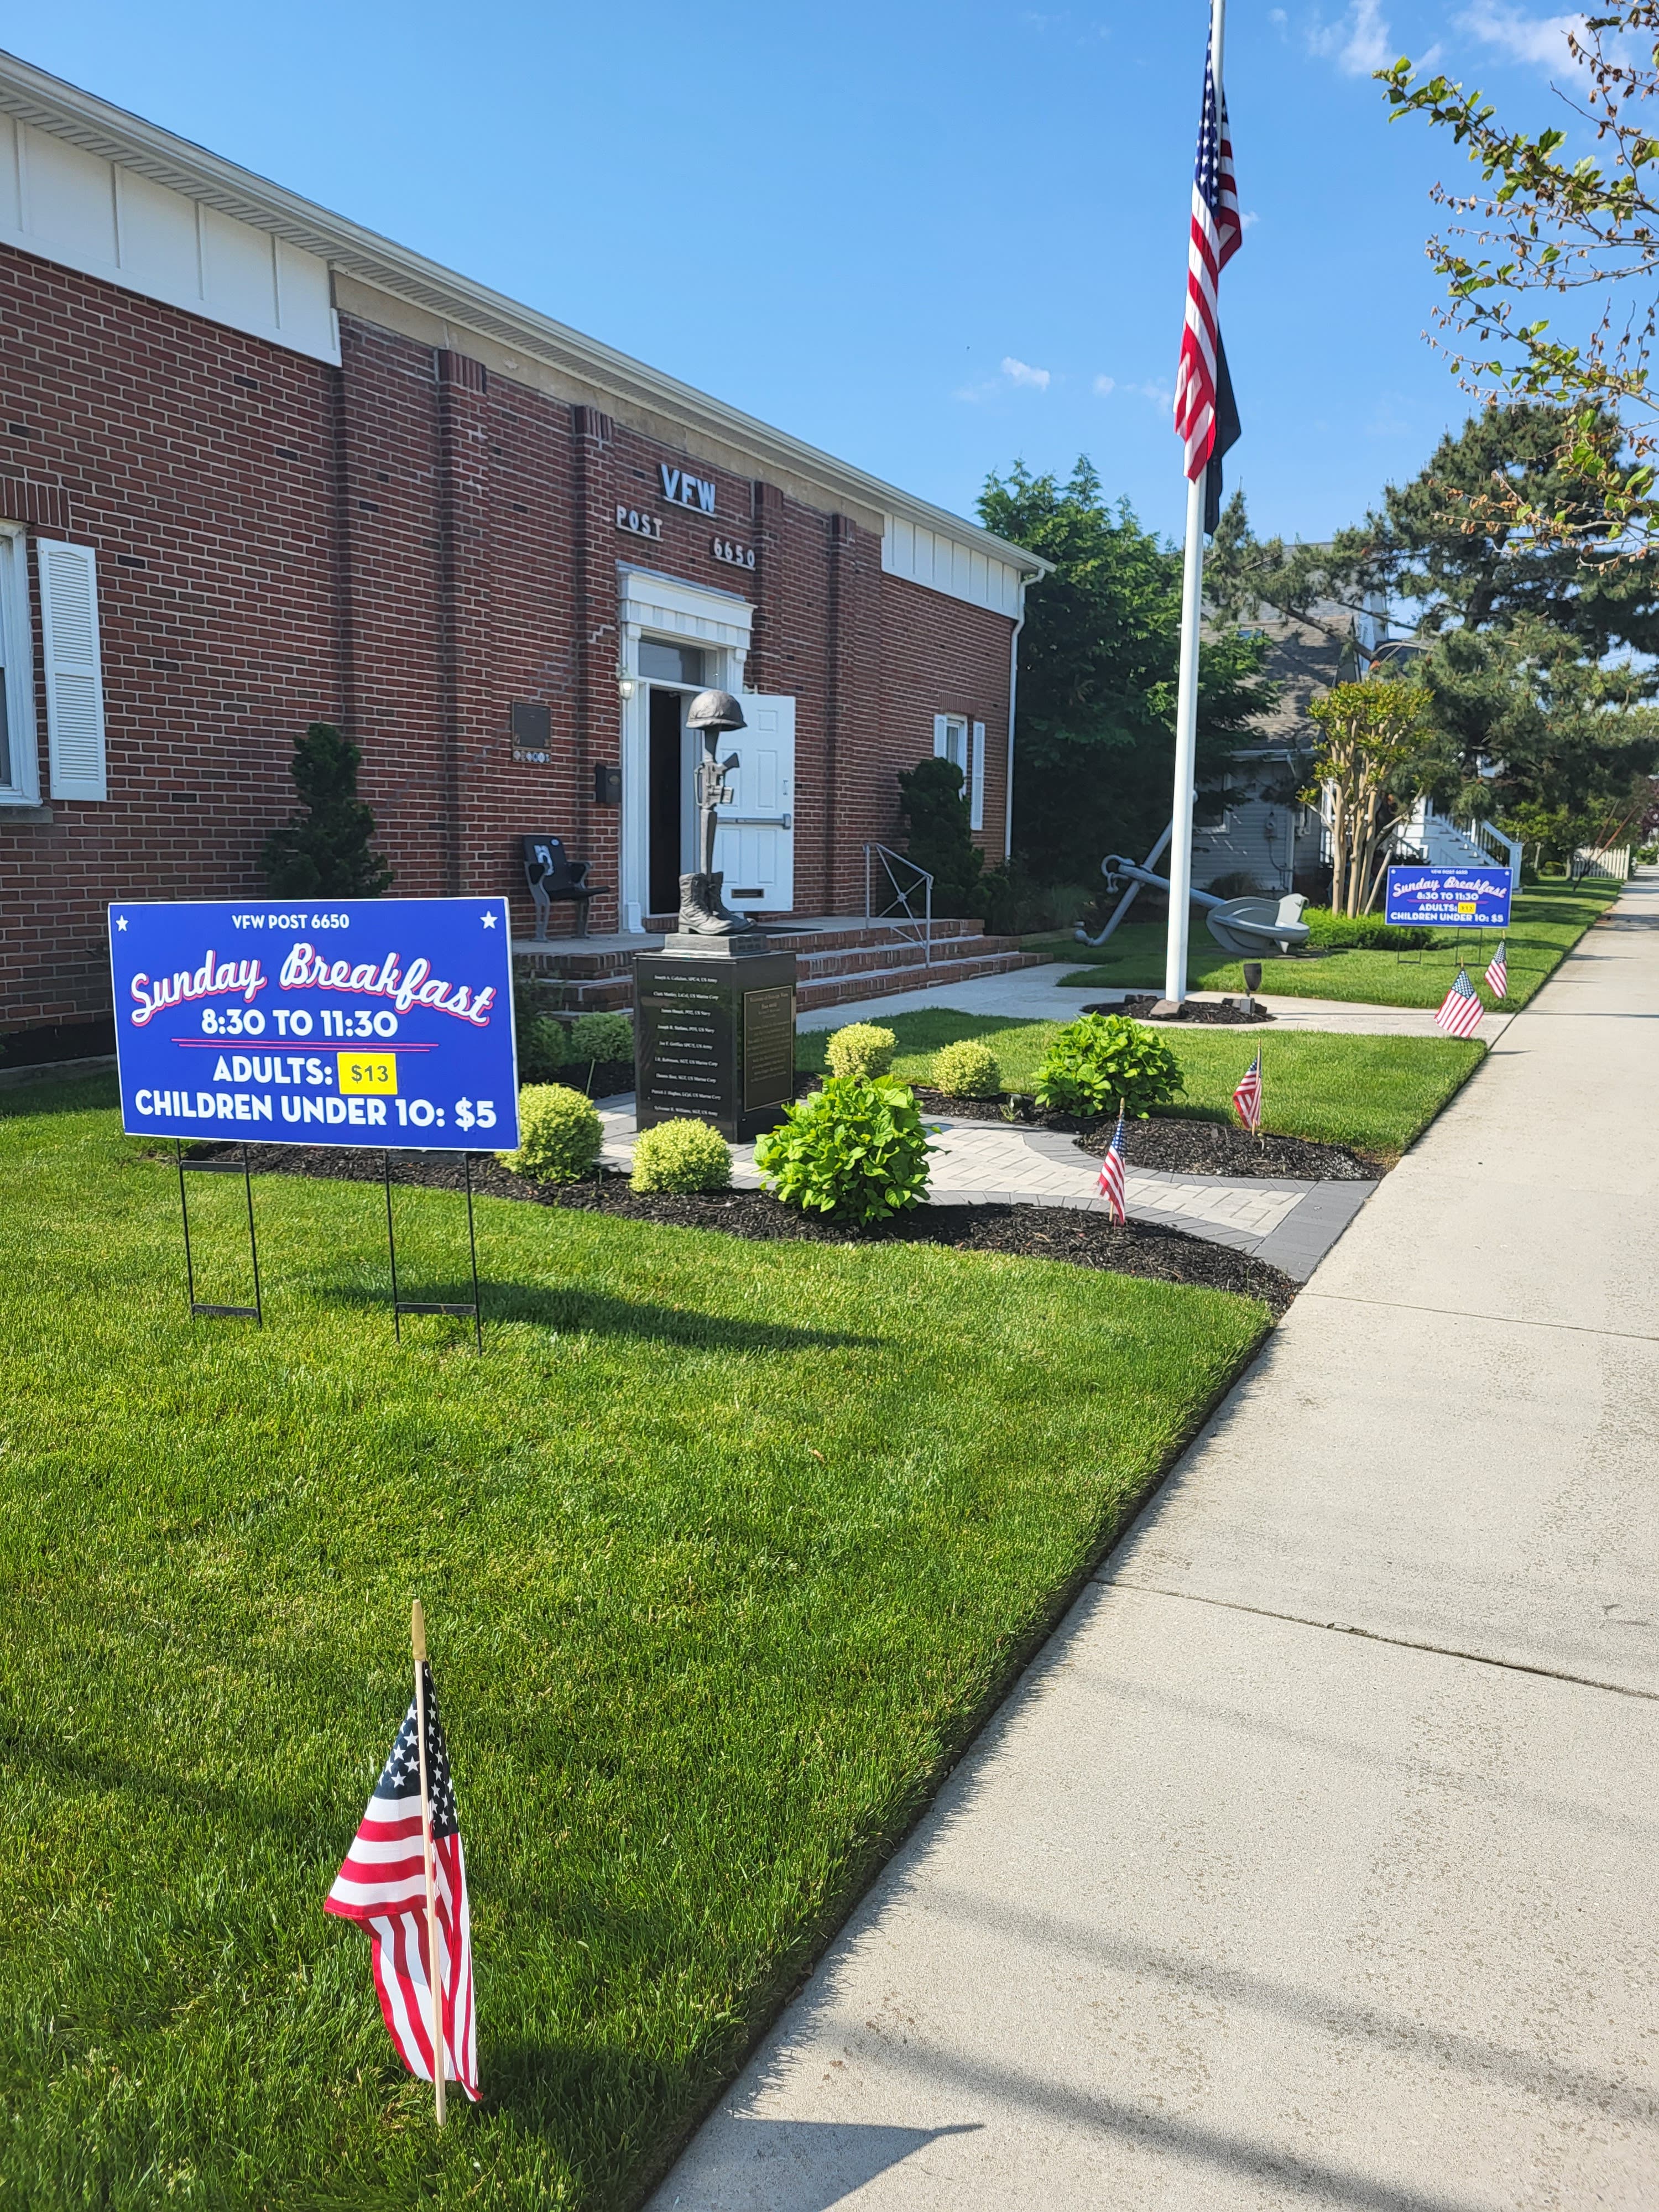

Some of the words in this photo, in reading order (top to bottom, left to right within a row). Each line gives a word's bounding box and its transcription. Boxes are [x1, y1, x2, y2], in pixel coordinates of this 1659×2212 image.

[660, 463, 716, 513] VFW
[615, 504, 662, 538] POST
[714, 537, 755, 568] 6650
[1392, 877, 1440, 898] Sunday
[1444, 876, 1507, 898] Breakfast
[1416, 891, 1438, 900] 8:30
[1440, 892, 1454, 900] TO
[1455, 892, 1479, 901] 11:30
[1390, 912, 1438, 920] CHILDREN
[1439, 913, 1473, 922] UNDER
[1474, 914, 1489, 922] 10:
[1491, 914, 1504, 923] $5
[1418, 903, 1457, 912] ADULTS:
[232, 915, 265, 930] VFW
[268, 914, 308, 930] POST
[311, 914, 350, 930] 6650
[131, 949, 267, 1026] Sunday
[279, 942, 497, 1027] Breakfast
[201, 1009, 265, 1035] 8:30
[272, 1009, 314, 1036] TO
[320, 1010, 399, 1037] 11:30
[212, 1055, 333, 1085] ADULTS:
[351, 1064, 389, 1084] $13
[135, 1089, 273, 1121] CHILDREN
[281, 1095, 388, 1126] UNDER
[394, 1098, 446, 1128] 10:
[455, 1097, 497, 1132] $5
